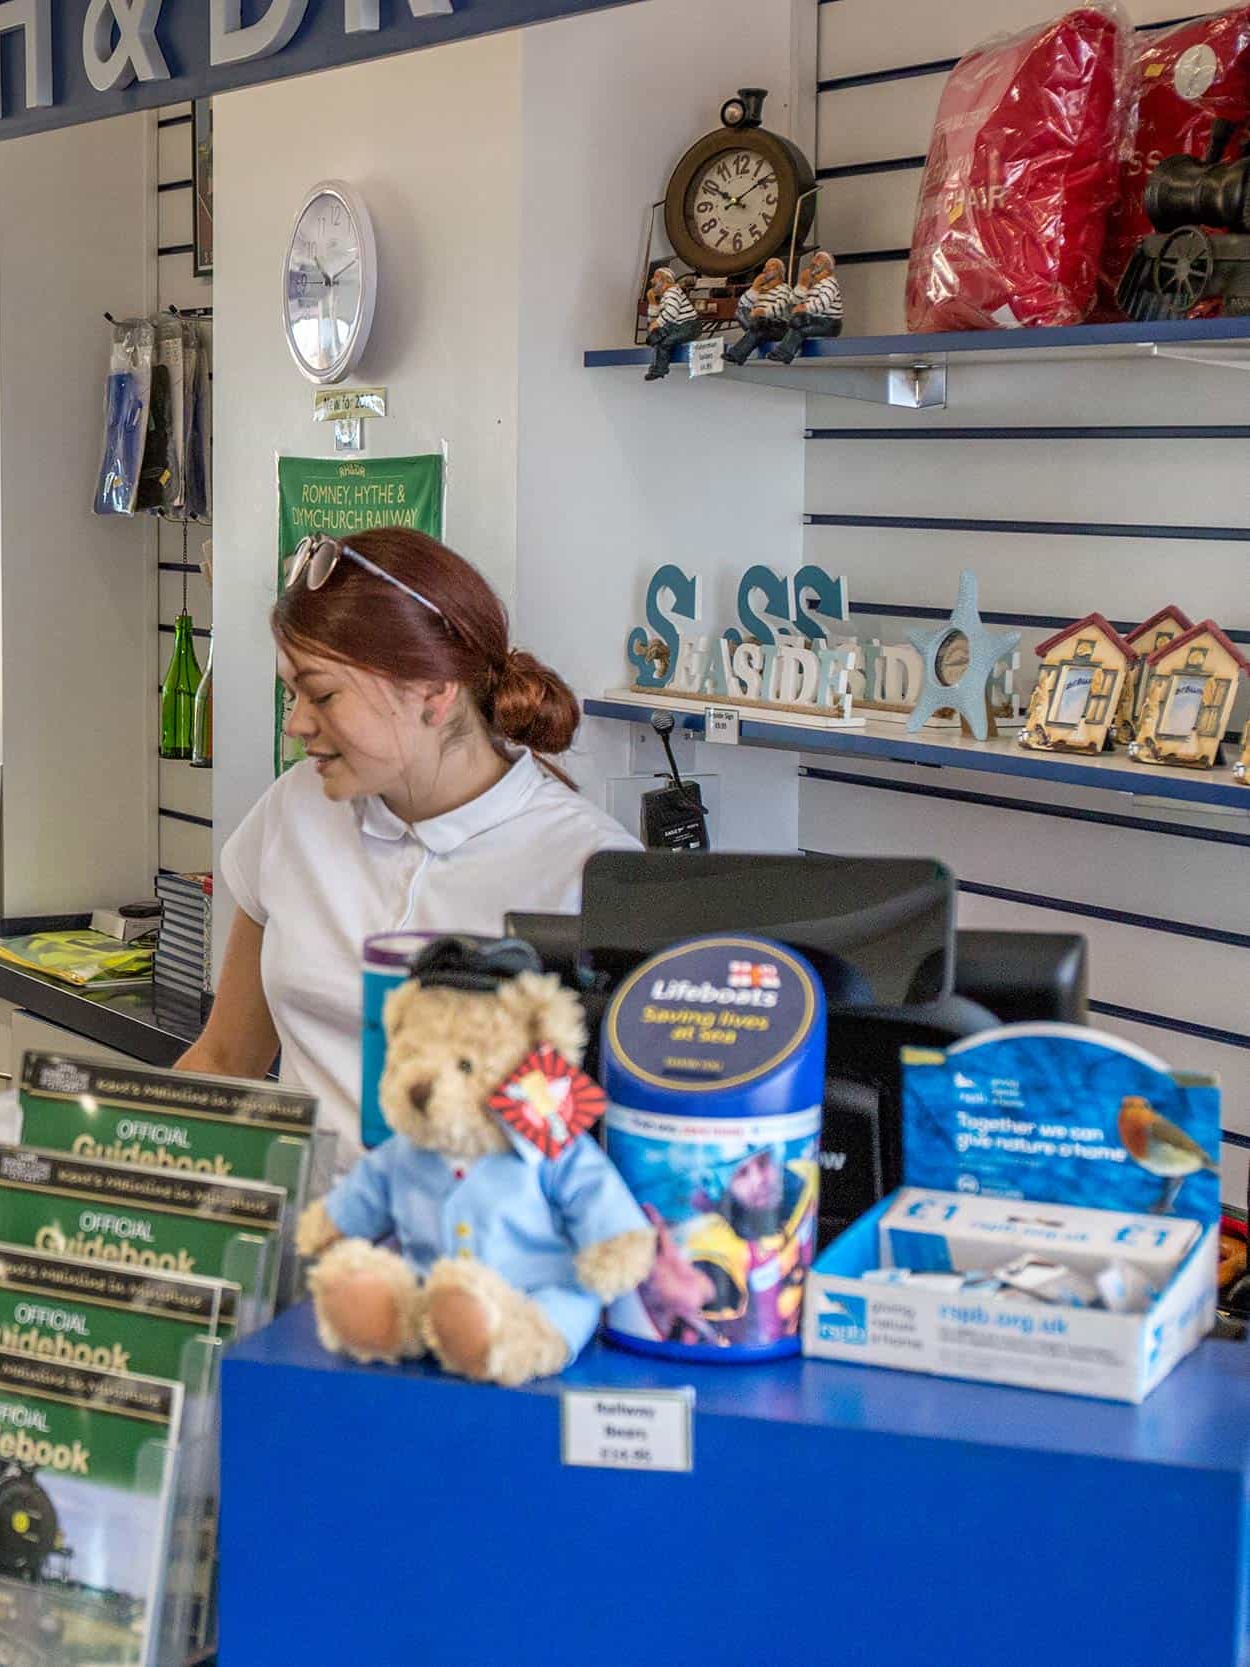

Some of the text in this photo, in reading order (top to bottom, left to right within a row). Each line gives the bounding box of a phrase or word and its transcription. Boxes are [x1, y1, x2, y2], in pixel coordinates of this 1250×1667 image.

[717, 160, 732, 182] 11
[733, 154, 750, 175] 12
[753, 160, 764, 177] 1
[701, 179, 720, 196] 10
[696, 201, 714, 213] 9
[765, 194, 777, 206] 3
[701, 218, 718, 234] 8
[748, 223, 762, 238] 5
[762, 212, 772, 226] 4
[715, 228, 730, 248] 7
[732, 232, 743, 252] 6
[355, 484, 394, 504] HYTHE
[397, 484, 406, 503] &
[292, 506, 364, 529] DYMCHURCH
[628, 564, 855, 722] SEASIDE
[650, 978, 780, 1008] Lifeboats
[641, 1005, 770, 1031] Saving lives
[116, 1119, 191, 1149] OFFICIAL
[956, 1111, 1105, 1142] Together we can
[72, 1132, 234, 1177] Guidebook
[956, 1131, 1128, 1163] give nature a home
[78, 1210, 156, 1243] OFFICIAL
[907, 1199, 959, 1222] £1
[1111, 1223, 1170, 1249] £1
[35, 1224, 197, 1274] Guidebook
[13, 1303, 91, 1336] OFFICIAL
[938, 1301, 1070, 1335] rspb.org.uk
